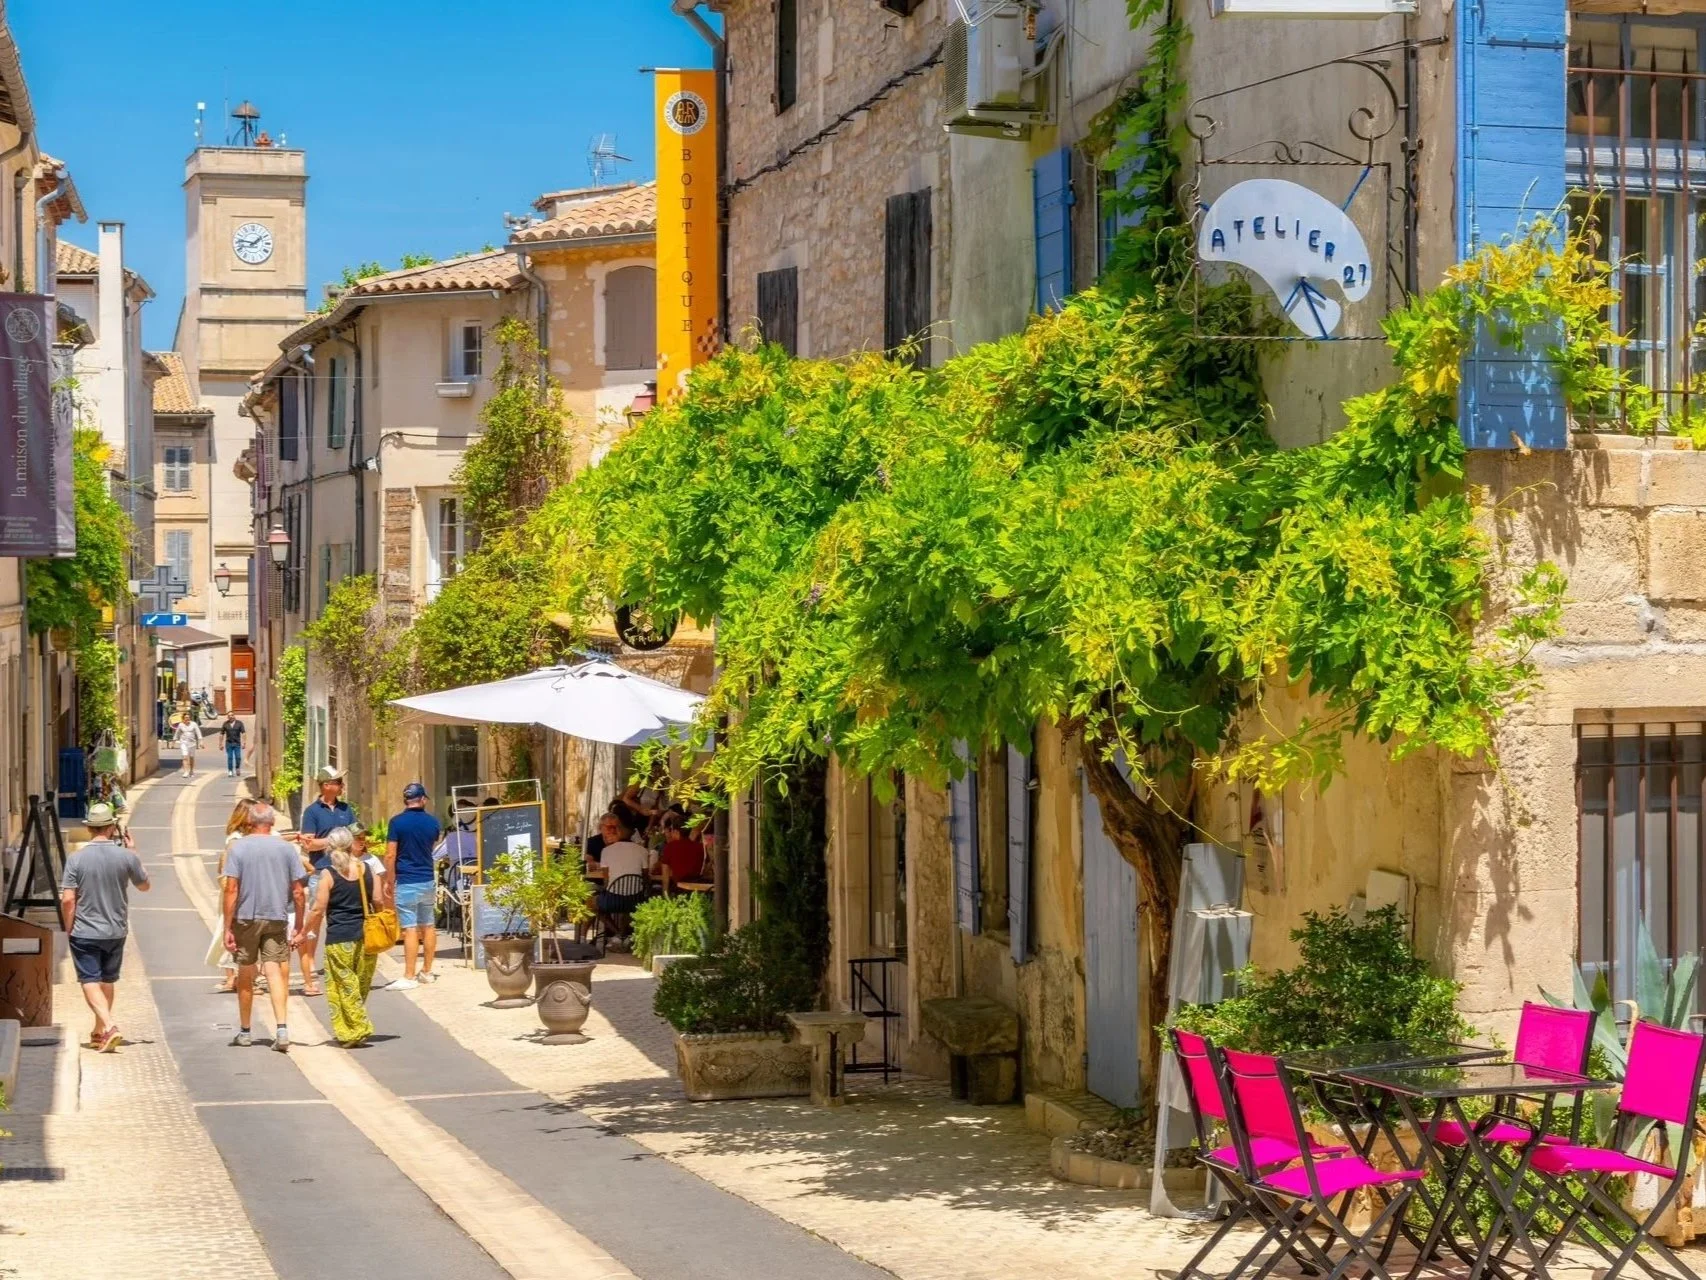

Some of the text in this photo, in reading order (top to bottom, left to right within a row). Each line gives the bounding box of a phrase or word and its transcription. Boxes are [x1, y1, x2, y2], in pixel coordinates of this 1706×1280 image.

[680, 148, 693, 332] BOUTIQUE
[1211, 215, 1367, 287] ATELIER 27
[13, 355, 33, 400] village
[12, 405, 28, 424] du
[12, 429, 27, 481] maison
[11, 486, 27, 498] la
[172, 615, 181, 625] P
